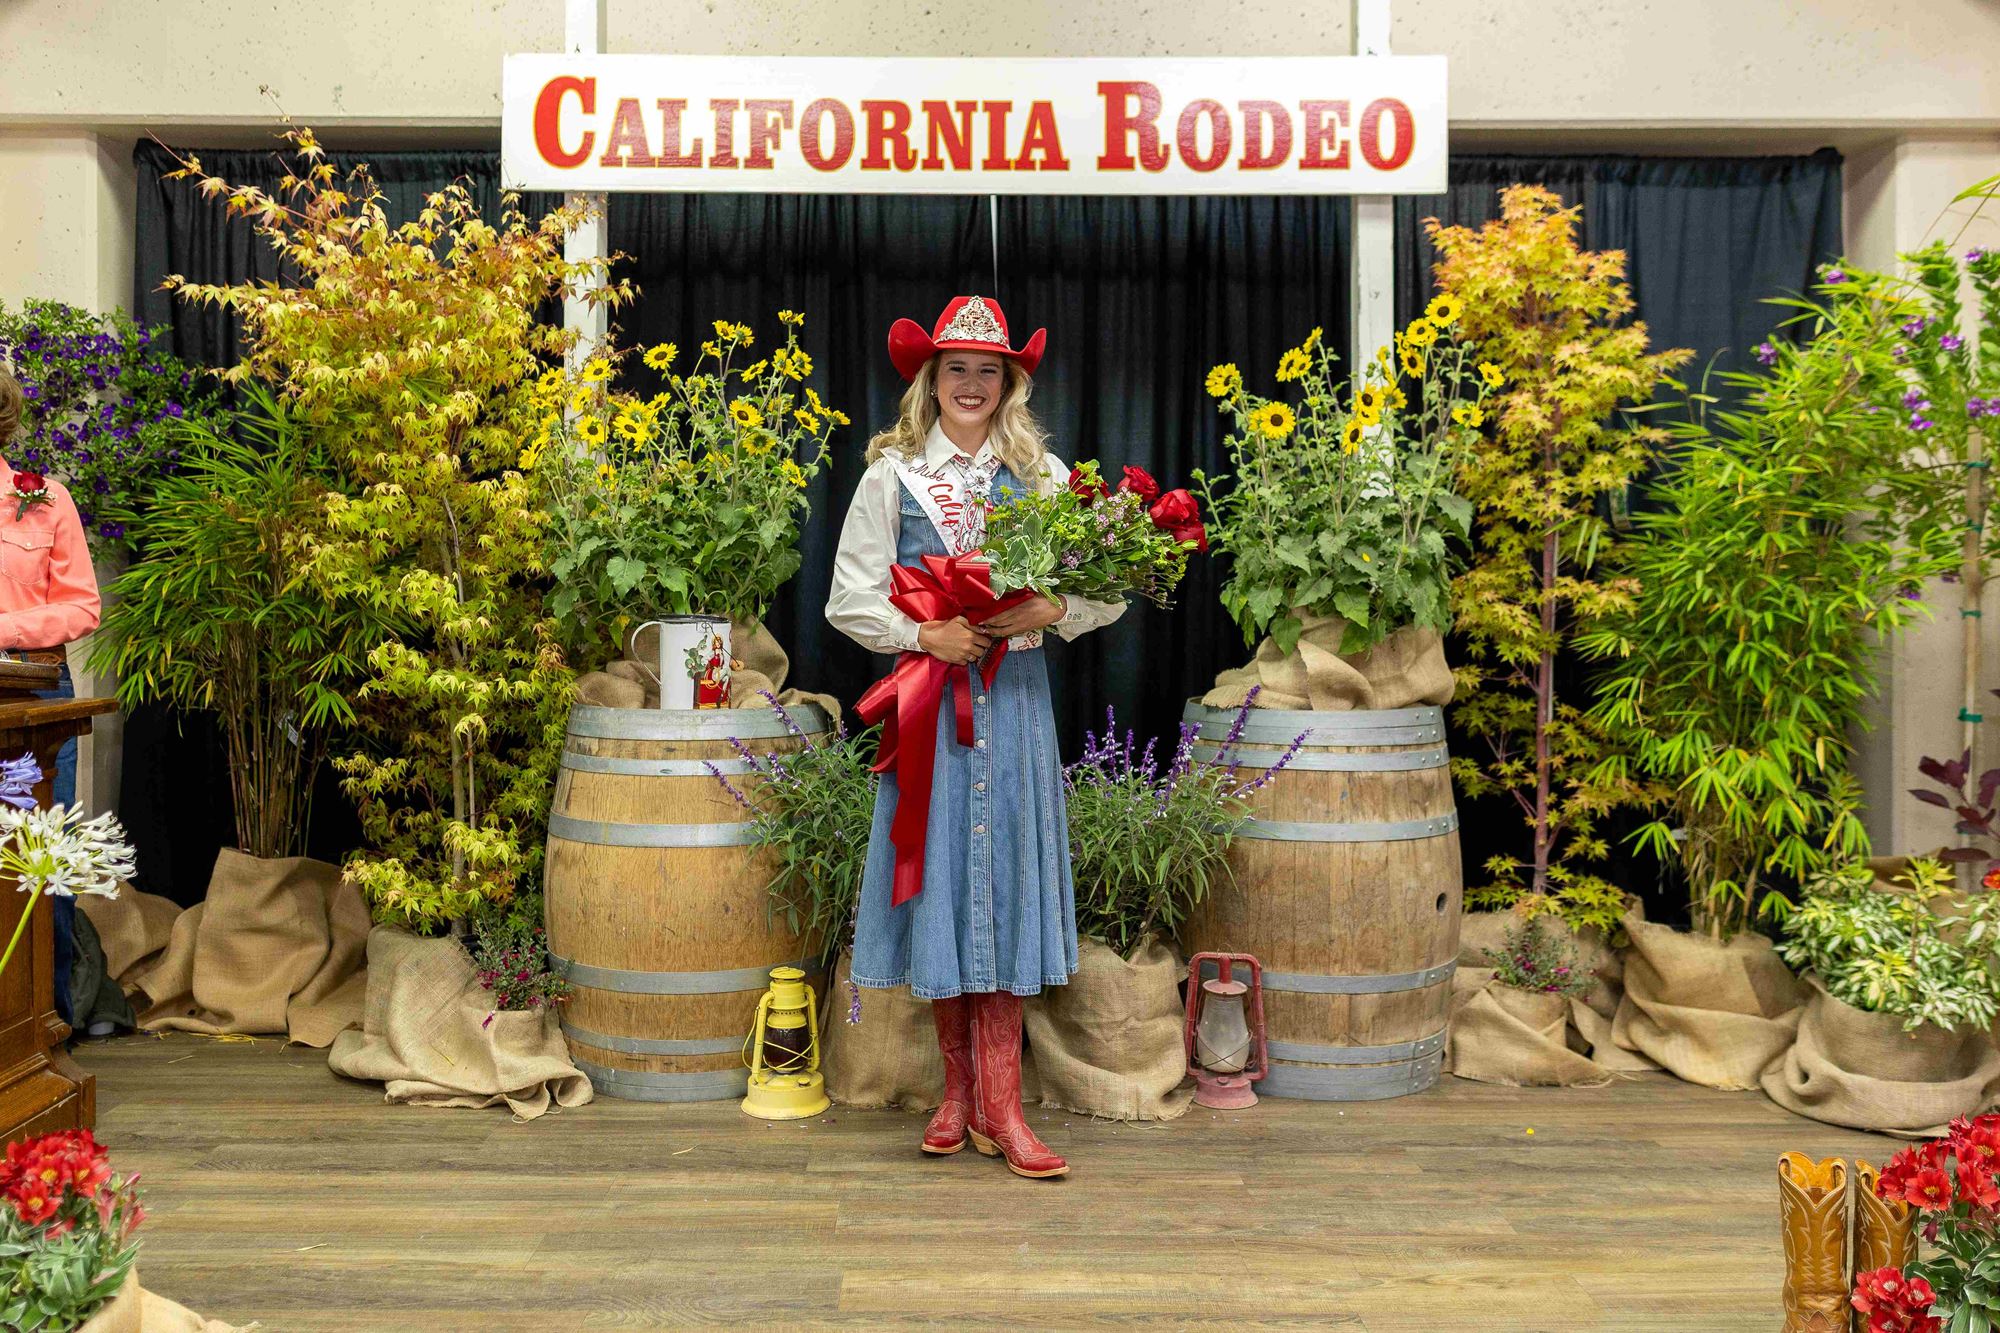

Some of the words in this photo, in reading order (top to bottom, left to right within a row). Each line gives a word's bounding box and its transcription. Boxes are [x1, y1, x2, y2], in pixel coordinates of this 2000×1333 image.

[533, 75, 1069, 171] CALIFORNIA
[1096, 81, 1416, 171] RODEO
[908, 462, 946, 481] Miss
